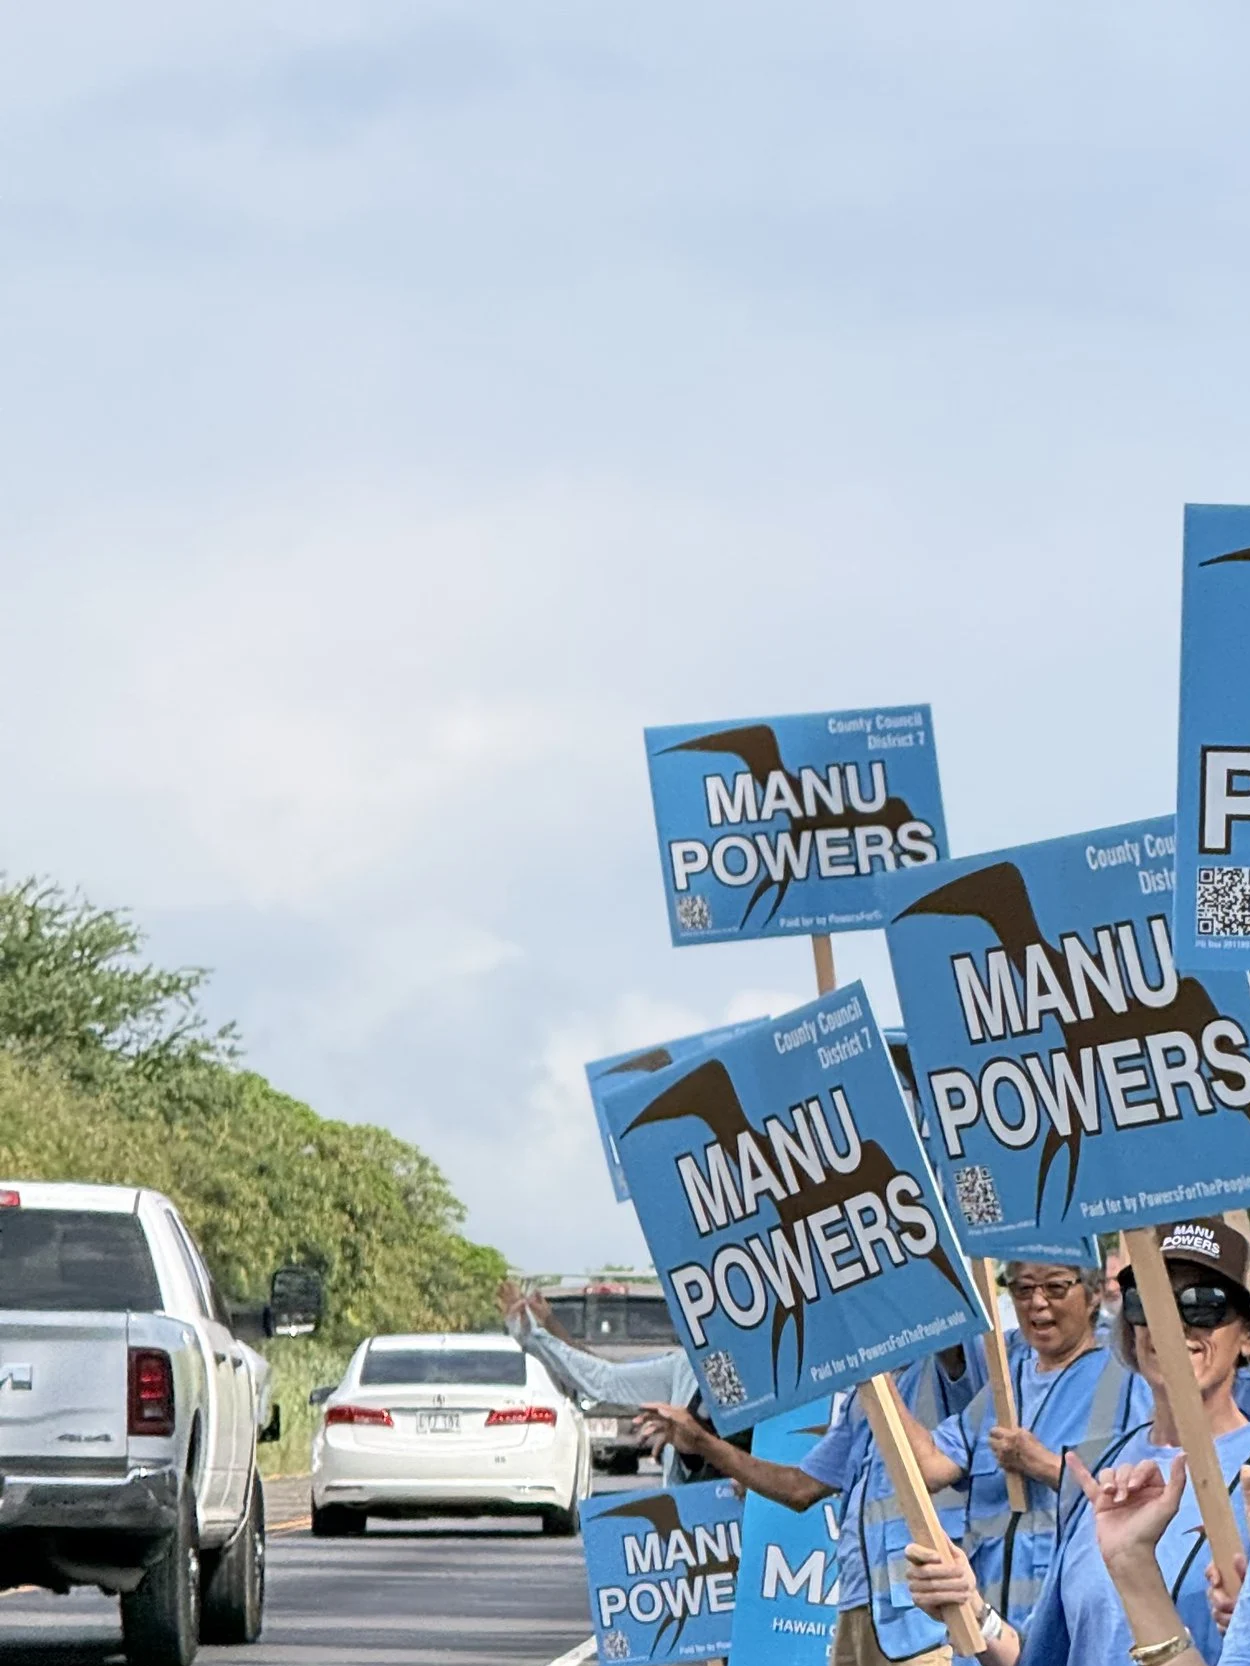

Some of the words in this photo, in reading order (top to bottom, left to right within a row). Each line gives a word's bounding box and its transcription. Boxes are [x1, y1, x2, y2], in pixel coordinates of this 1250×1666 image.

[827, 717, 873, 735] County
[875, 711, 923, 730] Council
[867, 733, 914, 750] District
[916, 730, 926, 746] 7
[704, 760, 889, 828] MANU
[669, 819, 940, 892] POWERS
[1085, 845, 1141, 871] County
[950, 912, 1179, 1046] MANU
[773, 1019, 819, 1055] County
[817, 995, 863, 1036] Council
[817, 1031, 865, 1070] District
[860, 1026, 873, 1050] 7
[675, 1083, 863, 1239] MANU
[1079, 1200, 1105, 1218] Paid
[1105, 1197, 1121, 1215] for
[1123, 1195, 1138, 1214] by
[1162, 1235, 1220, 1254] POWERS
[1173, 1224, 1215, 1240] MANU
[667, 1173, 940, 1350] POWERS
[810, 1360, 834, 1382] Paid
[831, 1358, 847, 1375] for
[847, 1354, 860, 1369] by
[597, 1571, 736, 1629] POWE
[772, 1616, 826, 1637] HAWAII
